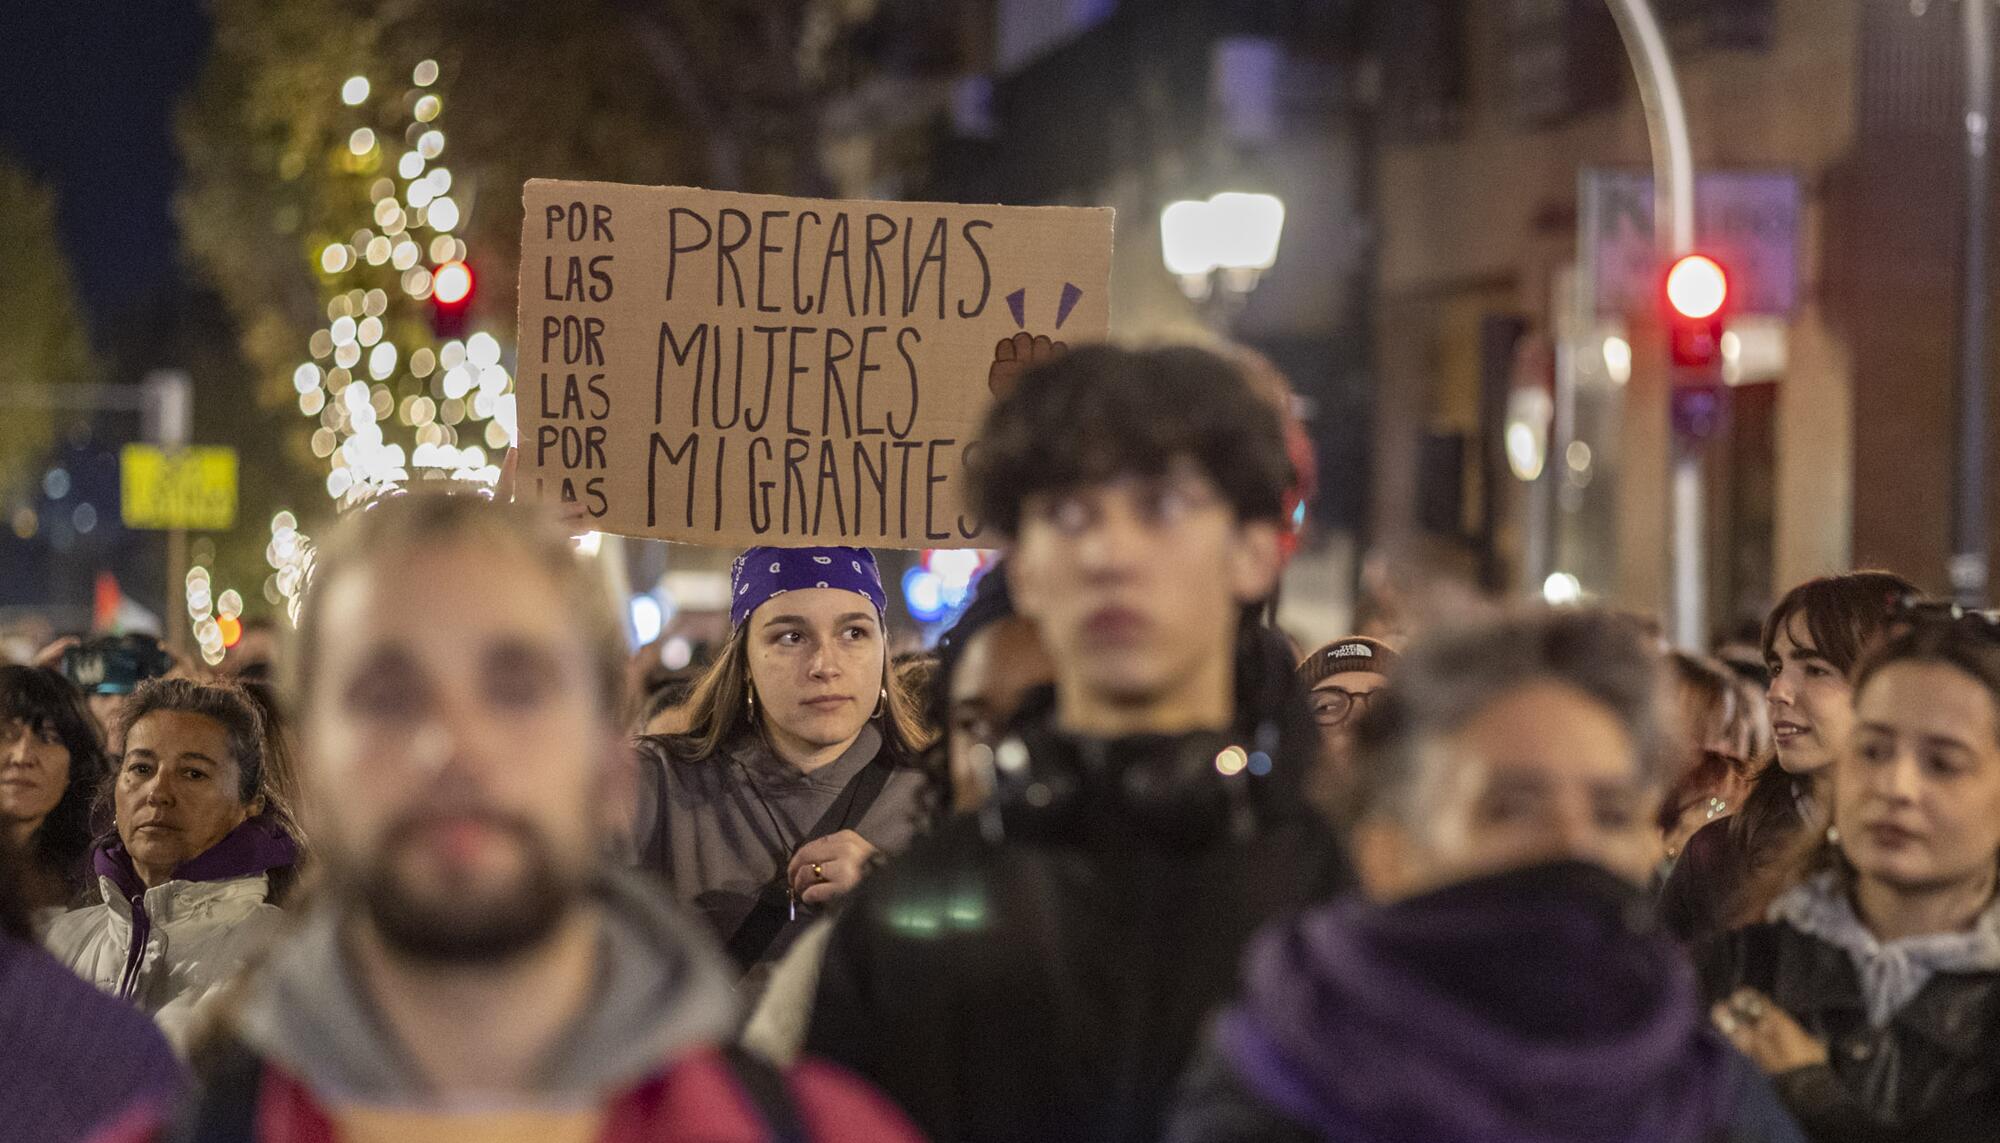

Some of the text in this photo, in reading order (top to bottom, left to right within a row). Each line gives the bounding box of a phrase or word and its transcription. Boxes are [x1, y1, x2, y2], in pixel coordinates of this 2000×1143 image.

[545, 202, 615, 242] POR
[544, 255, 613, 303] LAS
[665, 207, 993, 320] PRECARIAS
[541, 315, 606, 367] POR
[540, 373, 611, 421] LAS
[655, 322, 922, 440] MUJERES
[537, 425, 607, 470] POR
